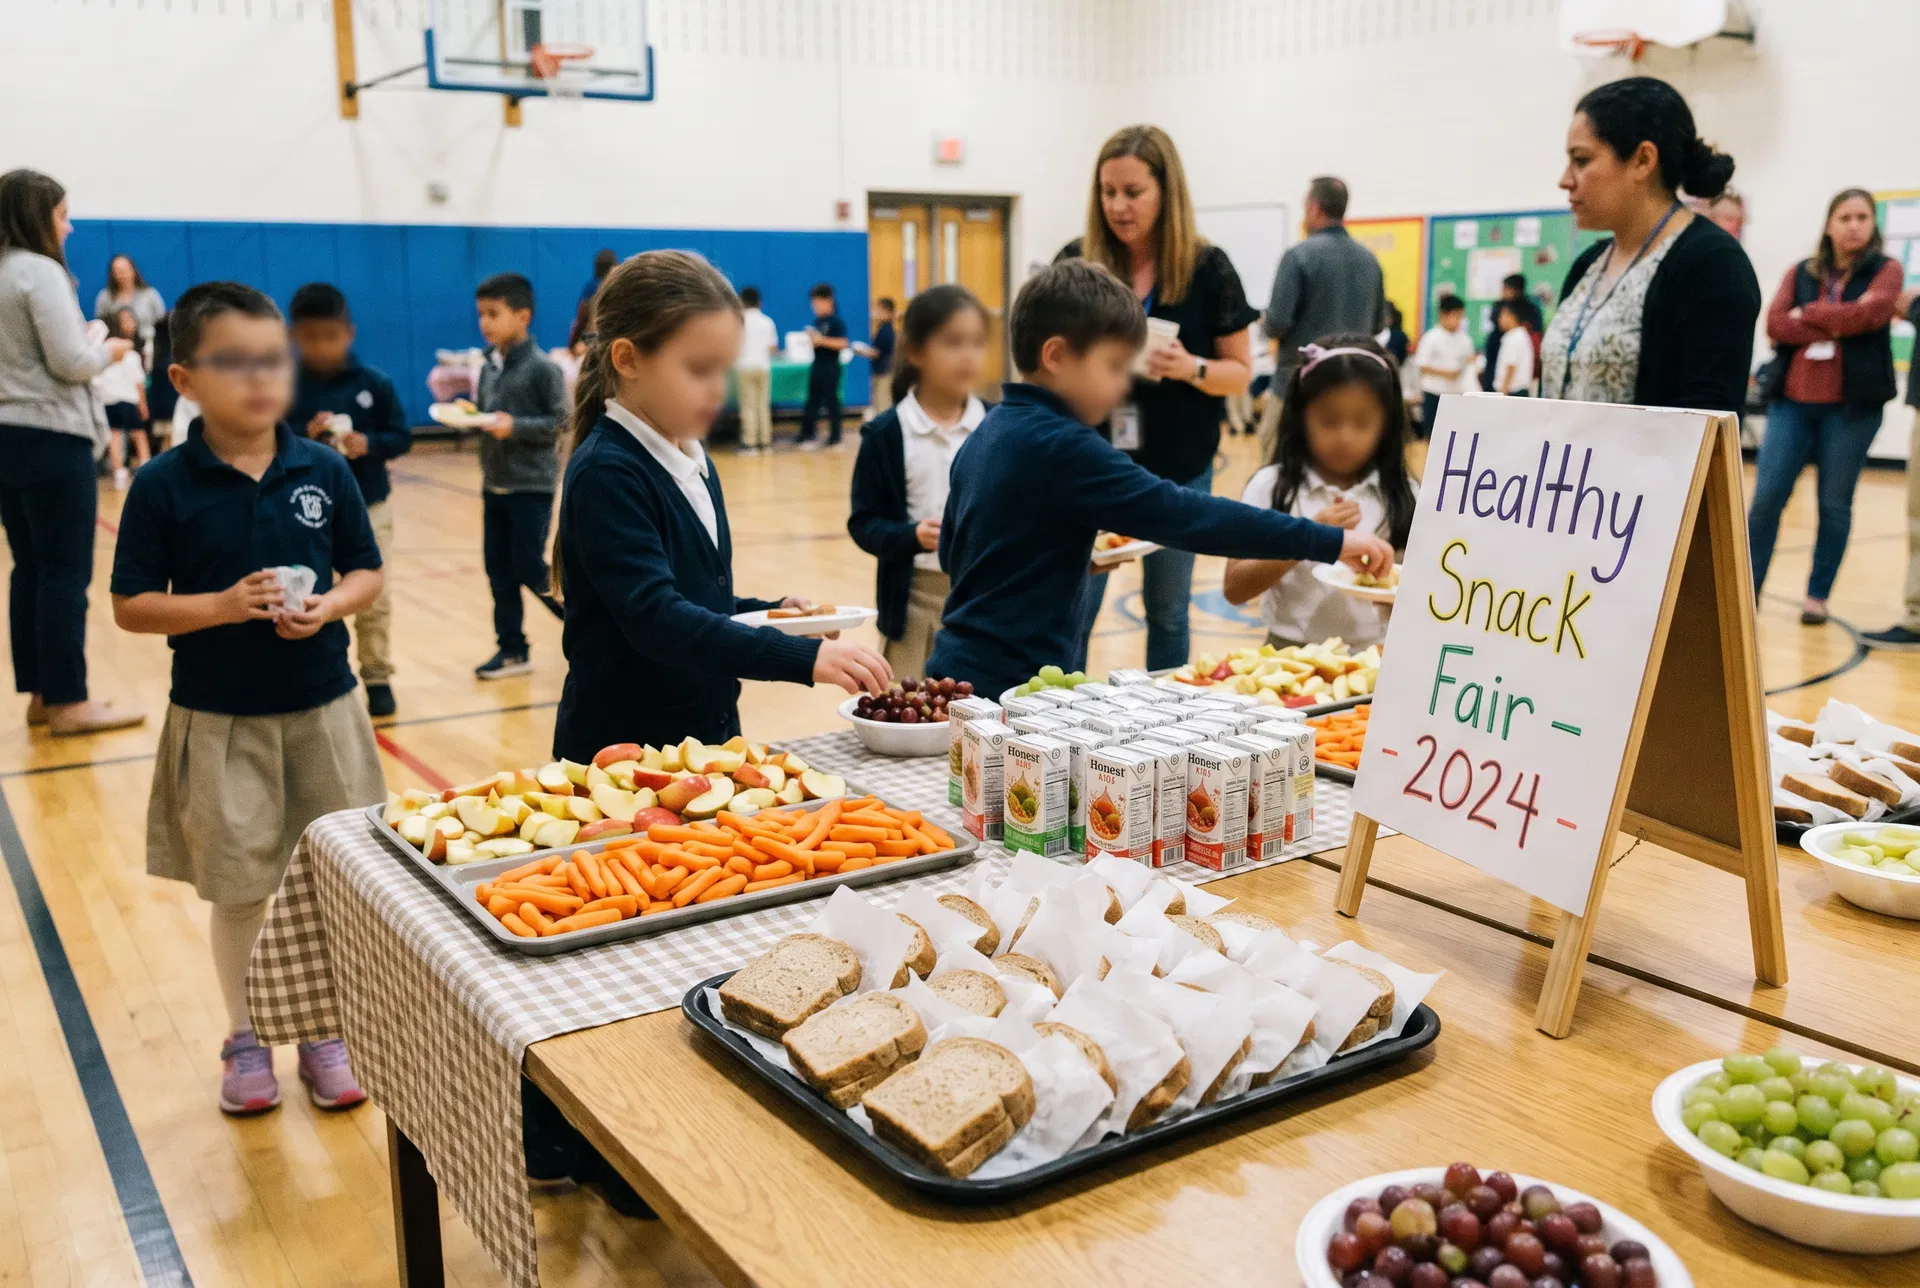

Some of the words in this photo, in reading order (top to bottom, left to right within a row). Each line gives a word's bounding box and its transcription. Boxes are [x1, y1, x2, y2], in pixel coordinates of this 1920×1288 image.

[1435, 430, 1644, 583] Healthy
[1428, 537, 1592, 660] Snack
[1429, 644, 1534, 741] Fair
[1007, 745, 1041, 764] Honest
[1090, 758, 1126, 778] Honest
[1187, 752, 1222, 771] Honest
[1402, 734, 1541, 850] 2024
